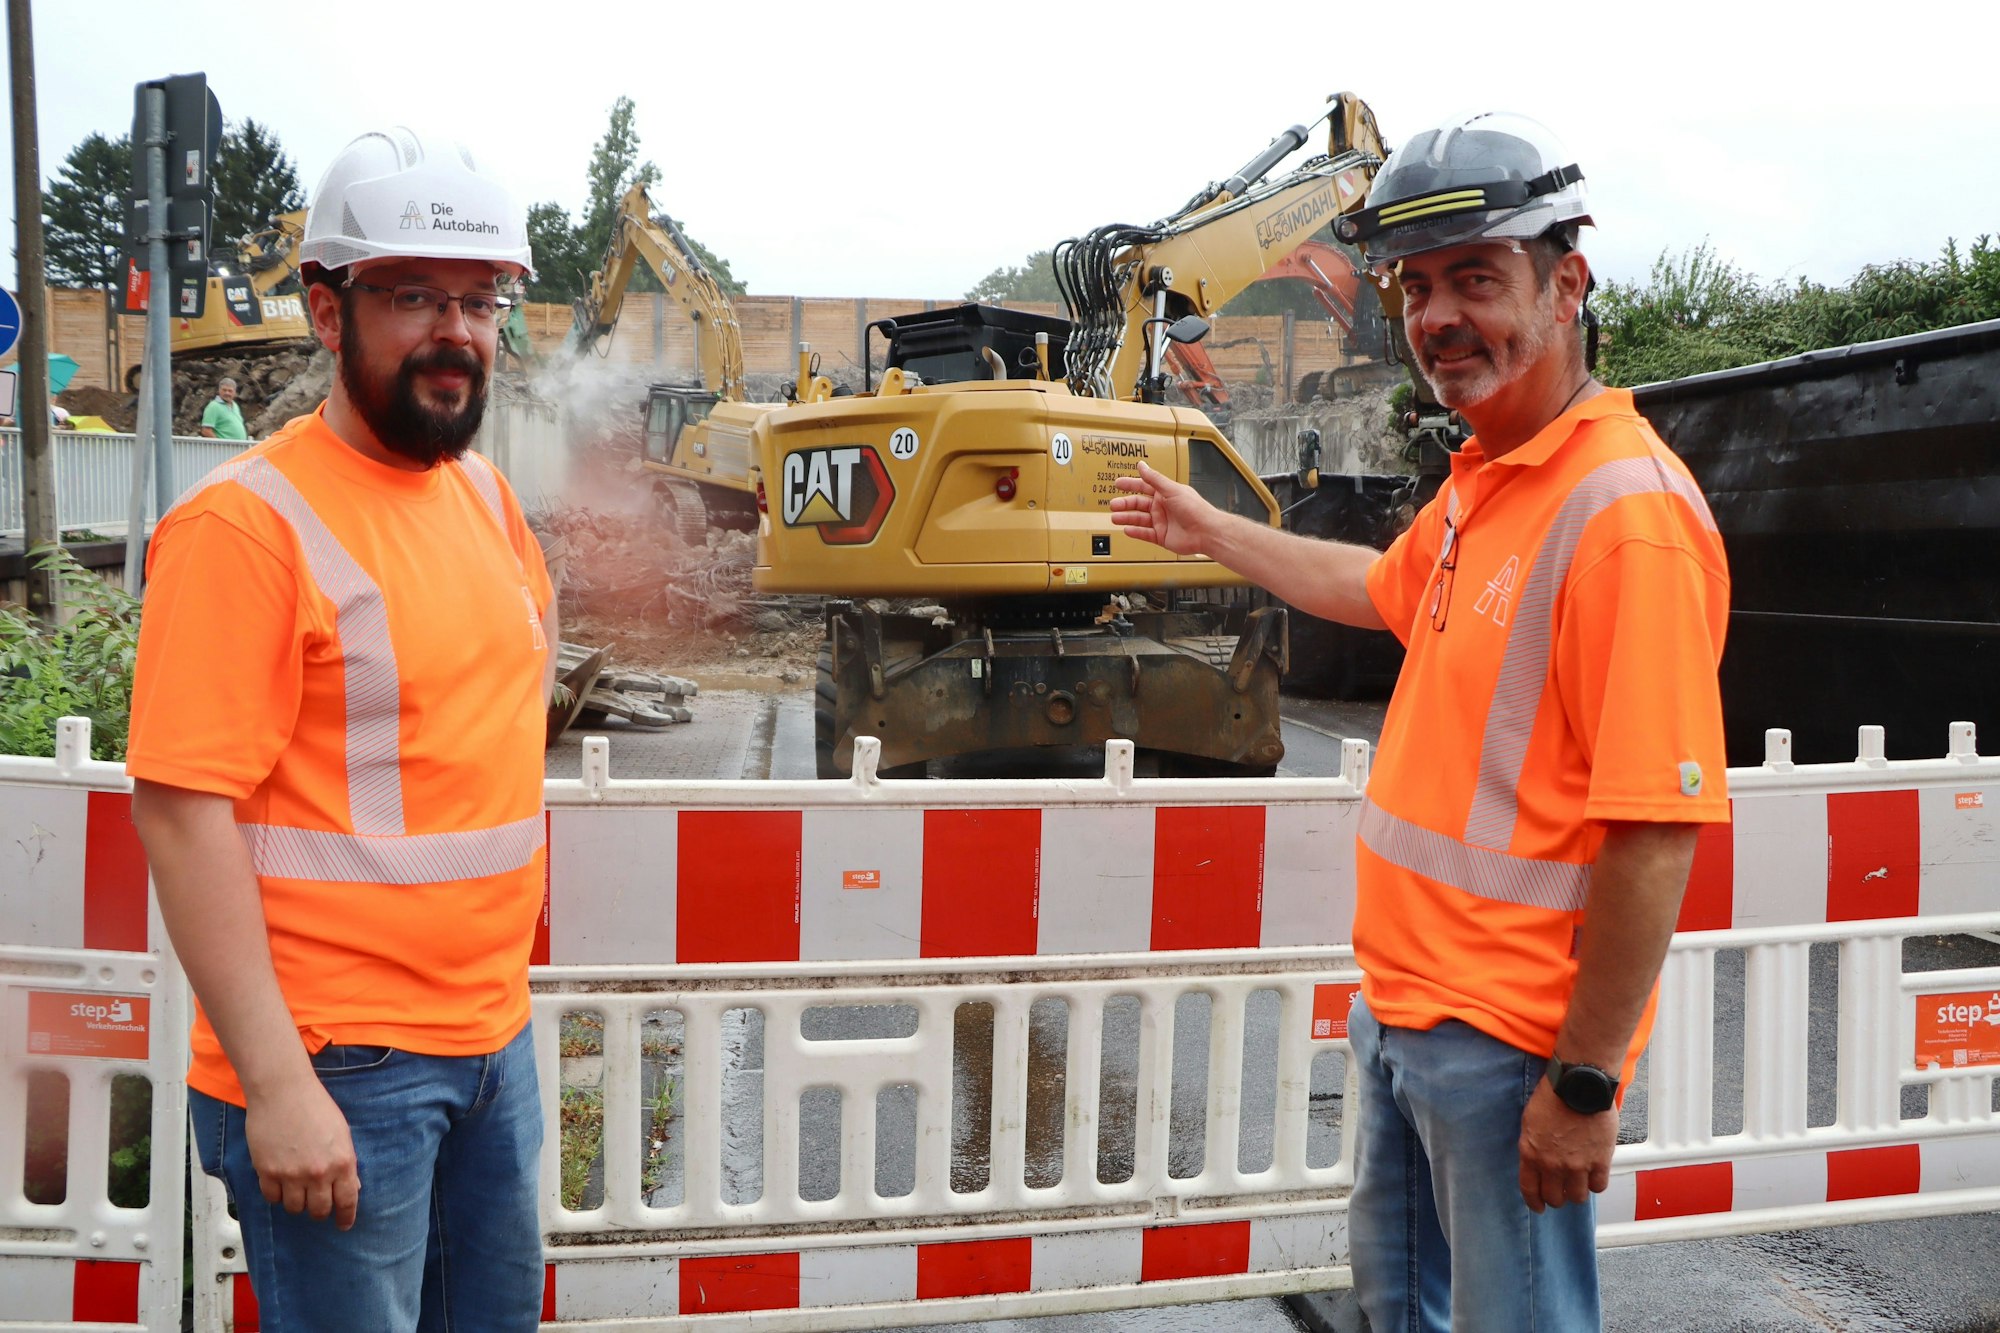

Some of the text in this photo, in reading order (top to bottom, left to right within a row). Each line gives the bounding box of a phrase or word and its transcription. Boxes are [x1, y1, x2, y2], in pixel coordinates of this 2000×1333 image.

[431, 203, 453, 216] Die
[1287, 189, 1337, 234] IMDAHL
[432, 218, 499, 234] Autobahn
[226, 287, 248, 302] CAT
[895, 433, 914, 454] 20
[1055, 439, 1069, 459] 20
[1107, 441, 1149, 458] IMDAHL
[1097, 472, 1116, 481] 52382
[783, 448, 860, 524] CAT
[1099, 484, 1107, 493] 24
[1958, 796, 1973, 805] step
[70, 1003, 107, 1021] step
[1937, 1003, 1982, 1027] step
[86, 1021, 146, 1033] Verkehrstechnik
